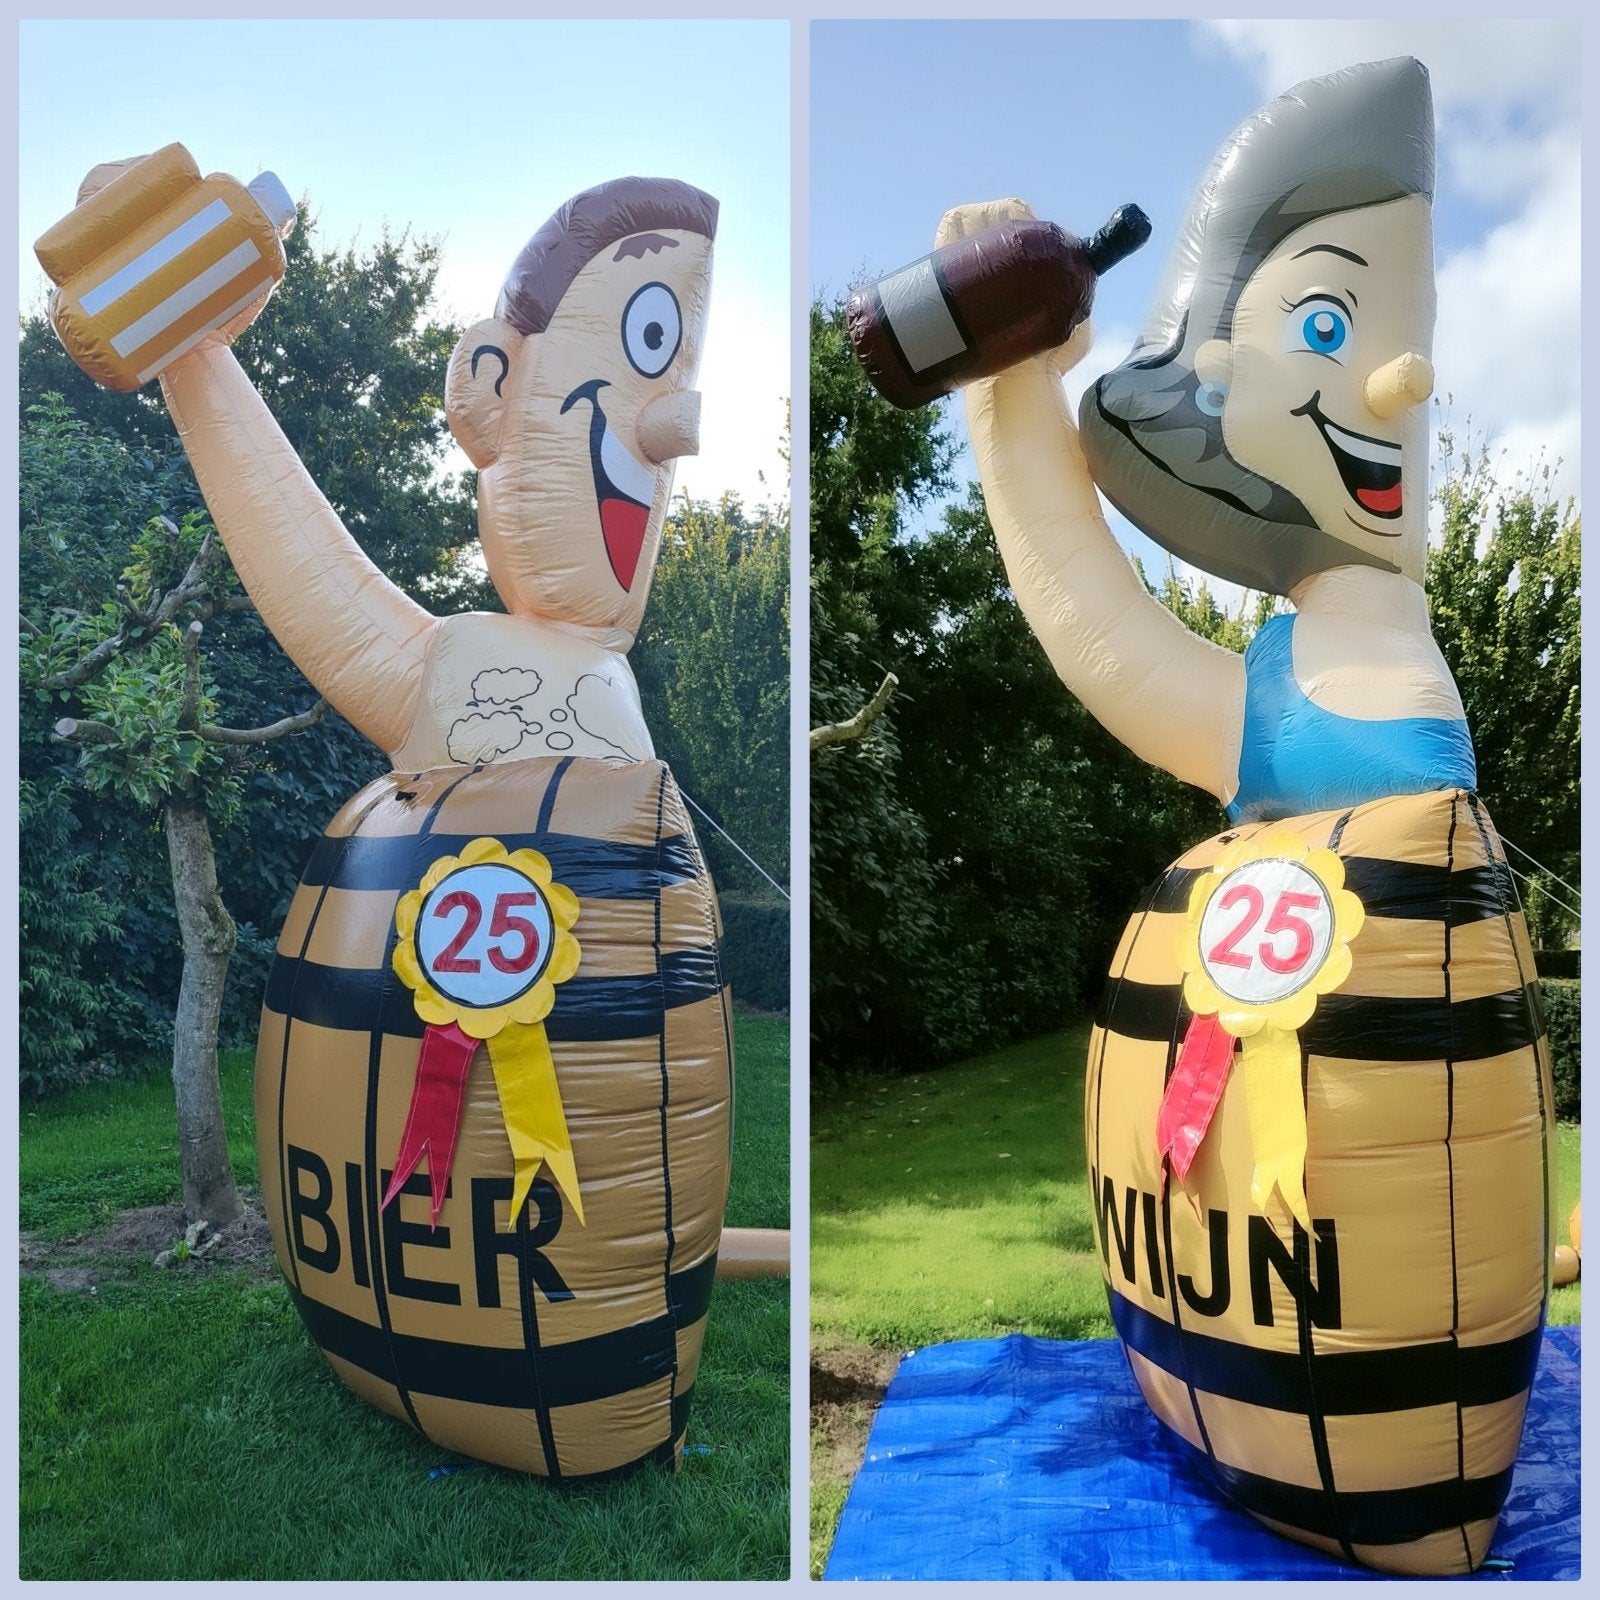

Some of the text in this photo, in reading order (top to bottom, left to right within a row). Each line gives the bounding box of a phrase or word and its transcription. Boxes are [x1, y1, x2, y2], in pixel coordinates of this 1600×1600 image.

[432, 890, 540, 974] 25
[1207, 884, 1322, 974] 25
[287, 1143, 576, 1309] BIER
[1090, 1165, 1343, 1330] WIJN
